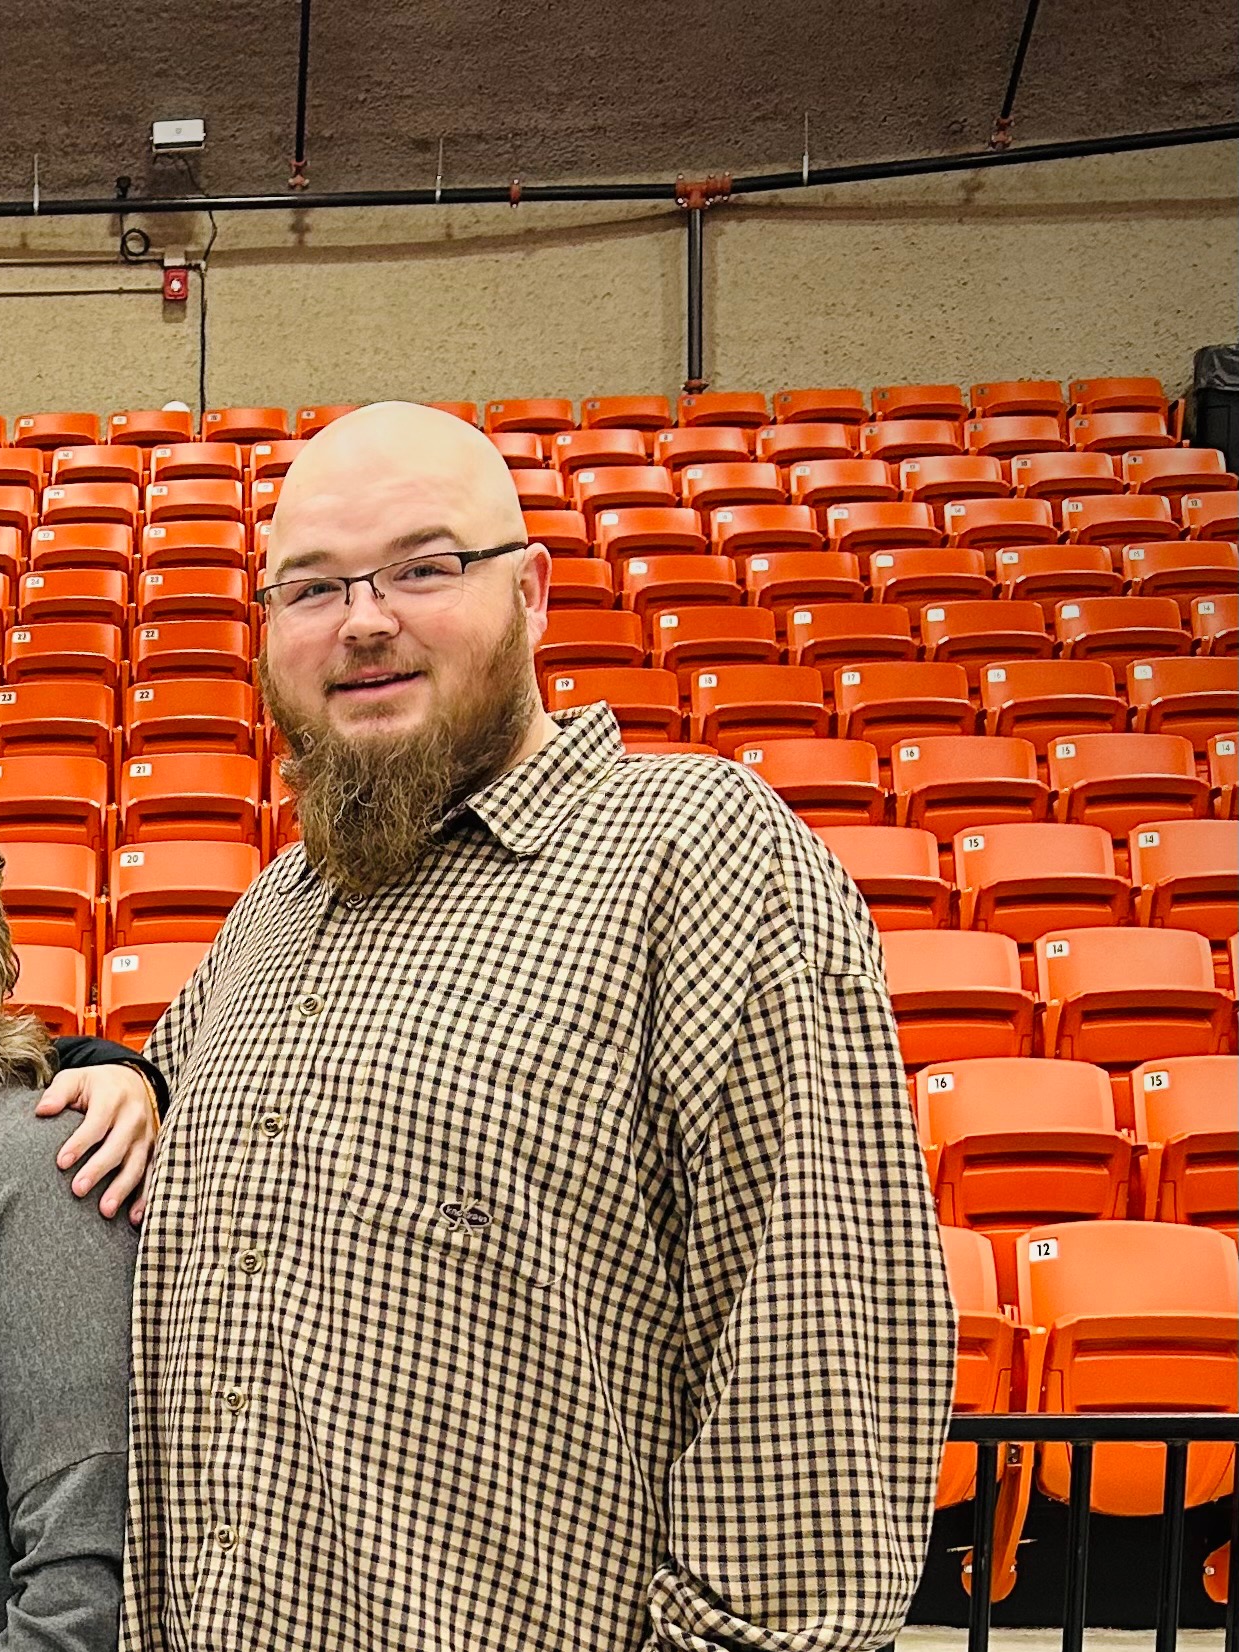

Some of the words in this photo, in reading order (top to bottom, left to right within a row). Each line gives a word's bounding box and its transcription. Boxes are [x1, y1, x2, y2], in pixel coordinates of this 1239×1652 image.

[1052, 943, 1064, 955] 14
[118, 958, 131, 967] 19
[934, 1077, 948, 1089] 16
[1150, 1074, 1163, 1087] 15
[1036, 1242, 1051, 1257] 12
